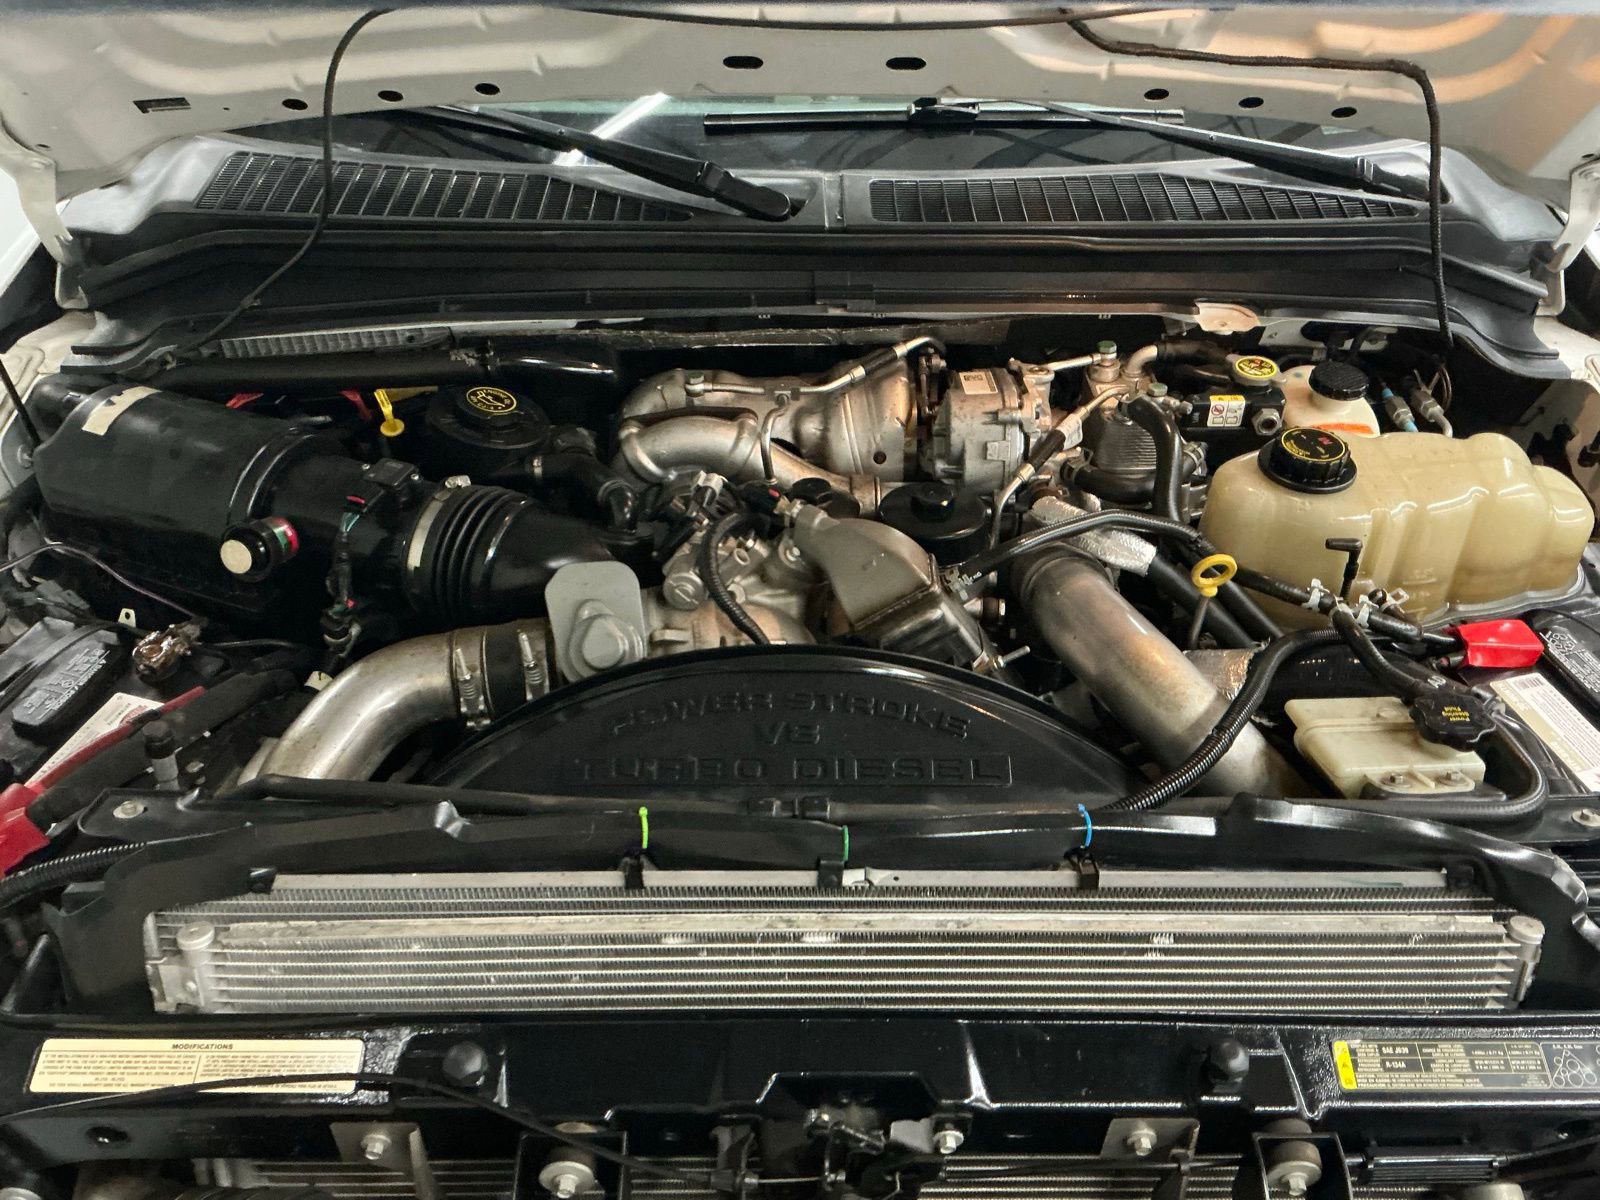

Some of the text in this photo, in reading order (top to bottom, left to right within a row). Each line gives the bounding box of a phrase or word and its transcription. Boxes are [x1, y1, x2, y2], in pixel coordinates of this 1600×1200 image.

[608, 691, 971, 741] POWER STROKE
[752, 720, 820, 745] V8
[574, 756, 1003, 781] TURBO DIESEL
